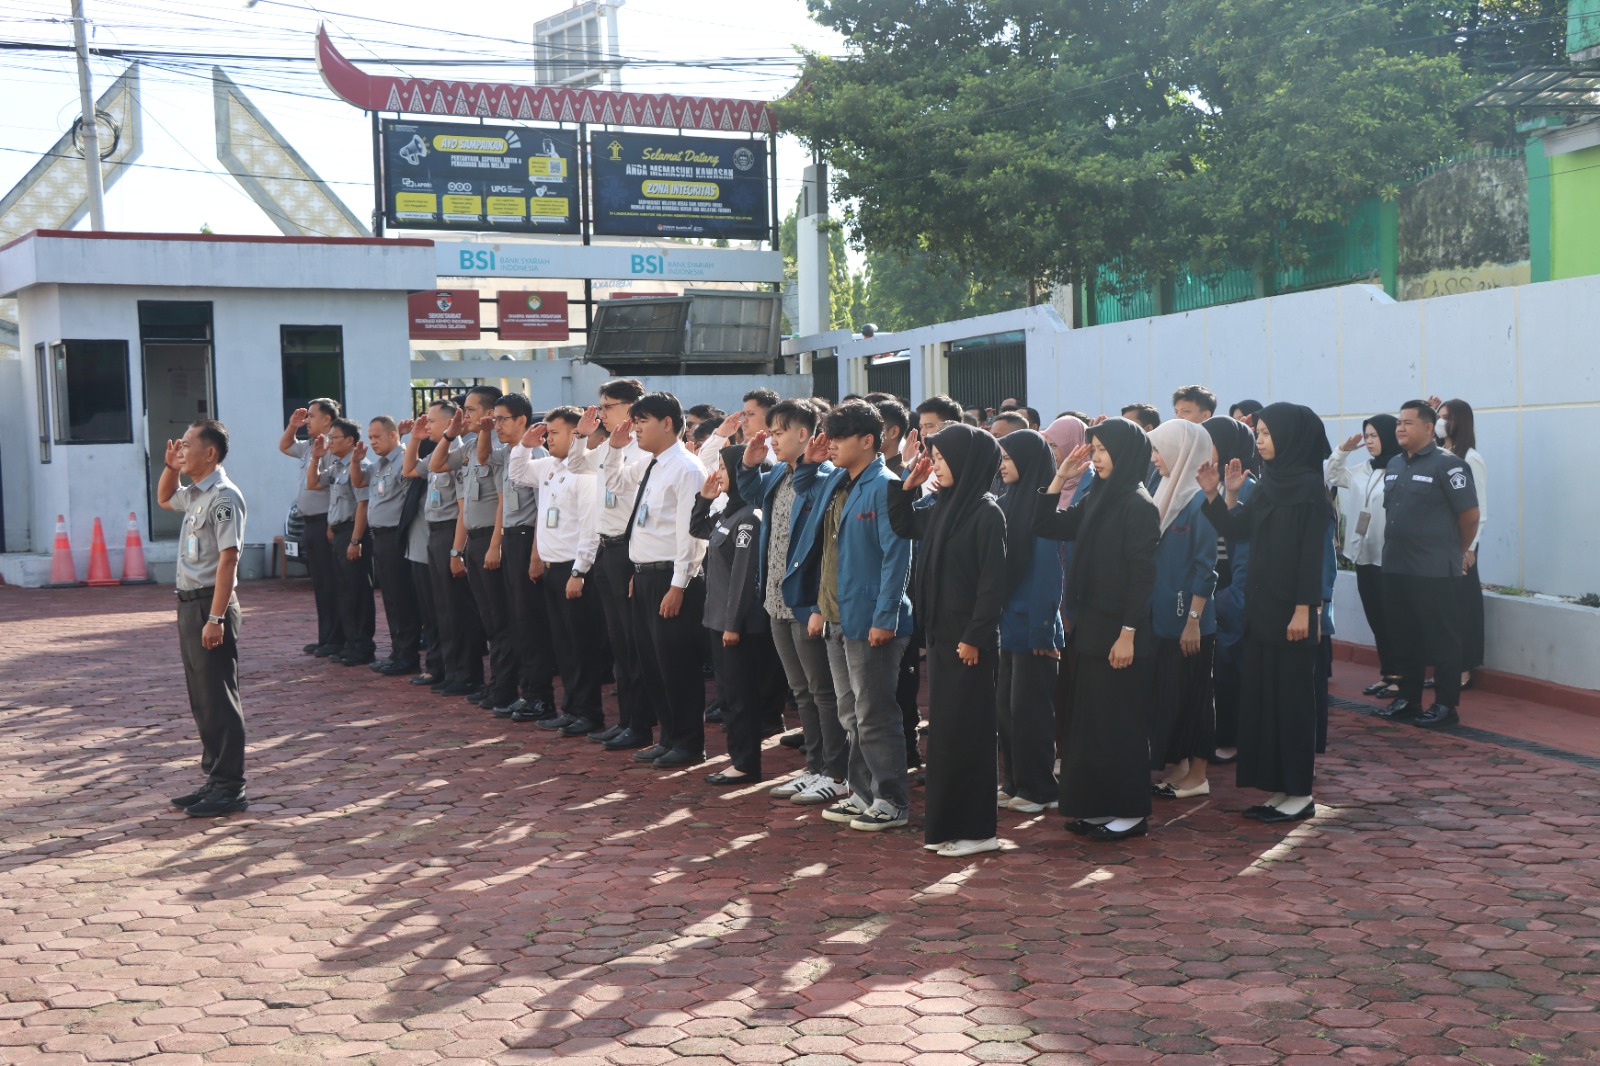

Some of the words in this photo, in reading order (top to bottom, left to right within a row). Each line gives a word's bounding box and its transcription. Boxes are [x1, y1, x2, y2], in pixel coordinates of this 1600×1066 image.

[441, 138, 459, 149] AYO
[459, 139, 504, 152] SAMPAIKAN
[641, 147, 682, 162] Selamat
[684, 149, 720, 167] Datang
[625, 163, 648, 176] ANDA
[649, 164, 693, 178] MEMASUKI
[695, 166, 734, 180] KAWASAN
[491, 185, 507, 193] UPG
[646, 183, 669, 194] ZONA
[671, 184, 717, 197] INTEGRITAS
[459, 249, 496, 271] BSI
[631, 254, 664, 275] BSI
[500, 264, 539, 272] INDONESIA
[667, 268, 704, 276] INDONESIA
